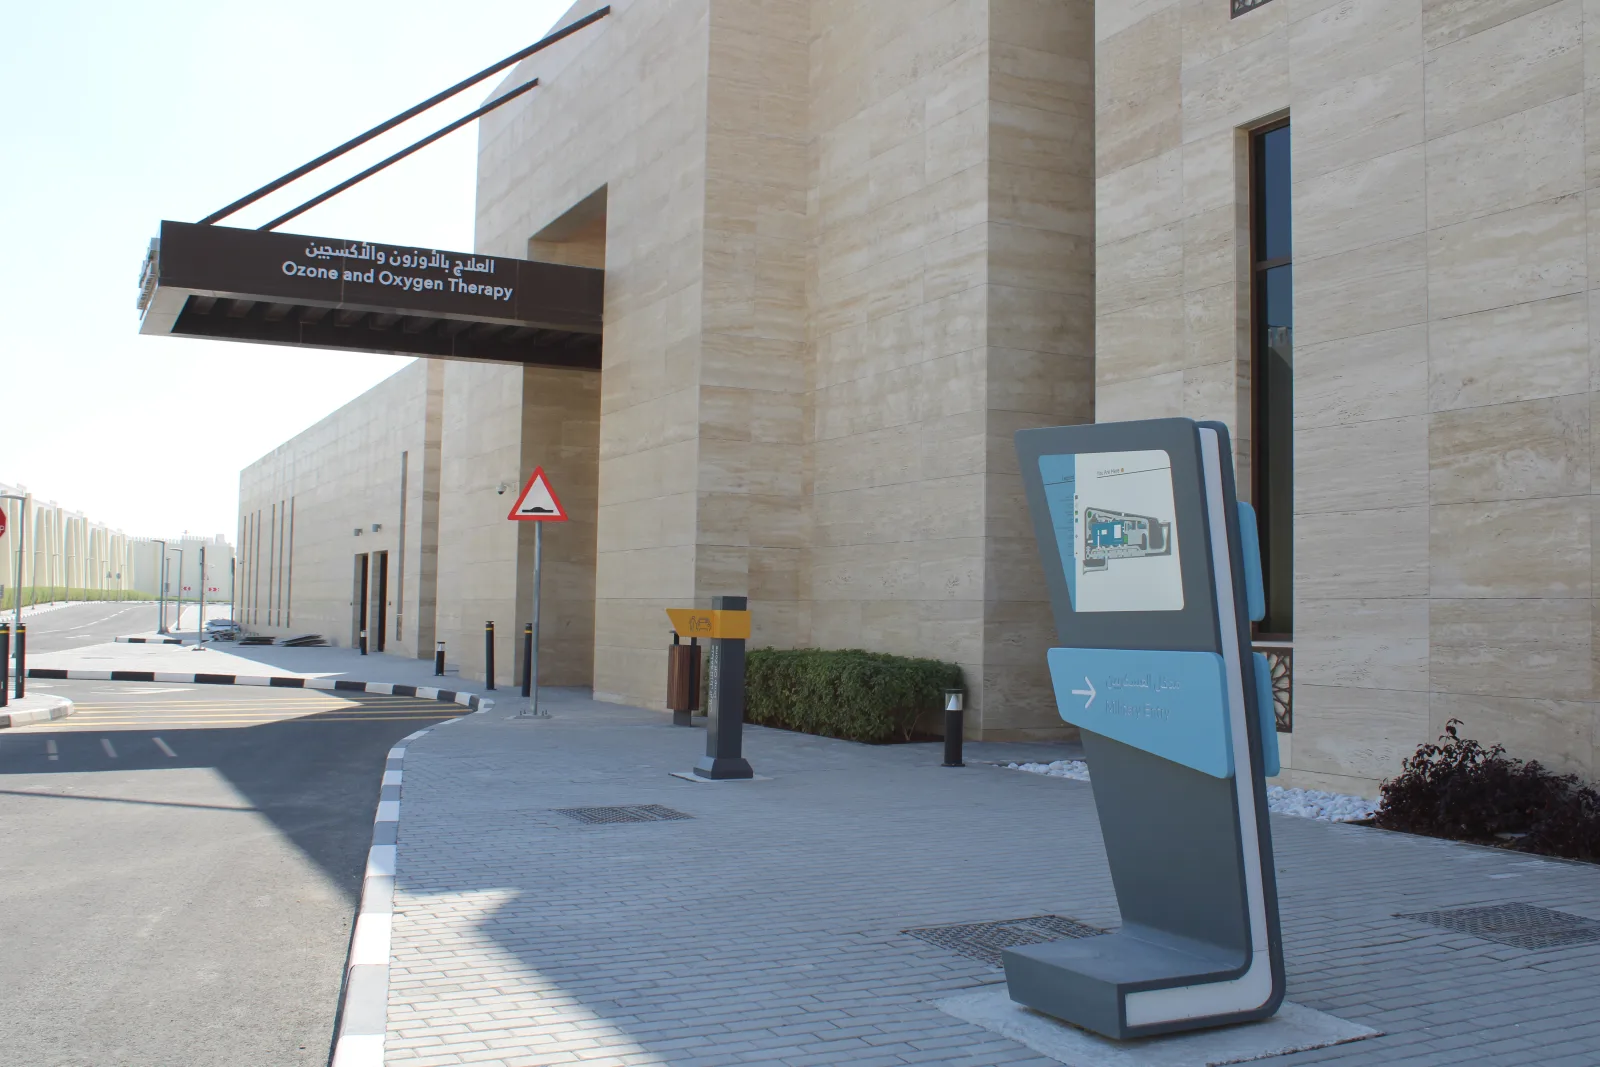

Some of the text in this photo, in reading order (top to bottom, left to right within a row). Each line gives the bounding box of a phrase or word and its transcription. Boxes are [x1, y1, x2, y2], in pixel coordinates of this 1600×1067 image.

[305, 241, 495, 276] العلاج بالأوزون والأكسجين
[282, 260, 514, 301] Ozone and Oxygen Therapy
[1105, 700, 1171, 721] Military Entry
